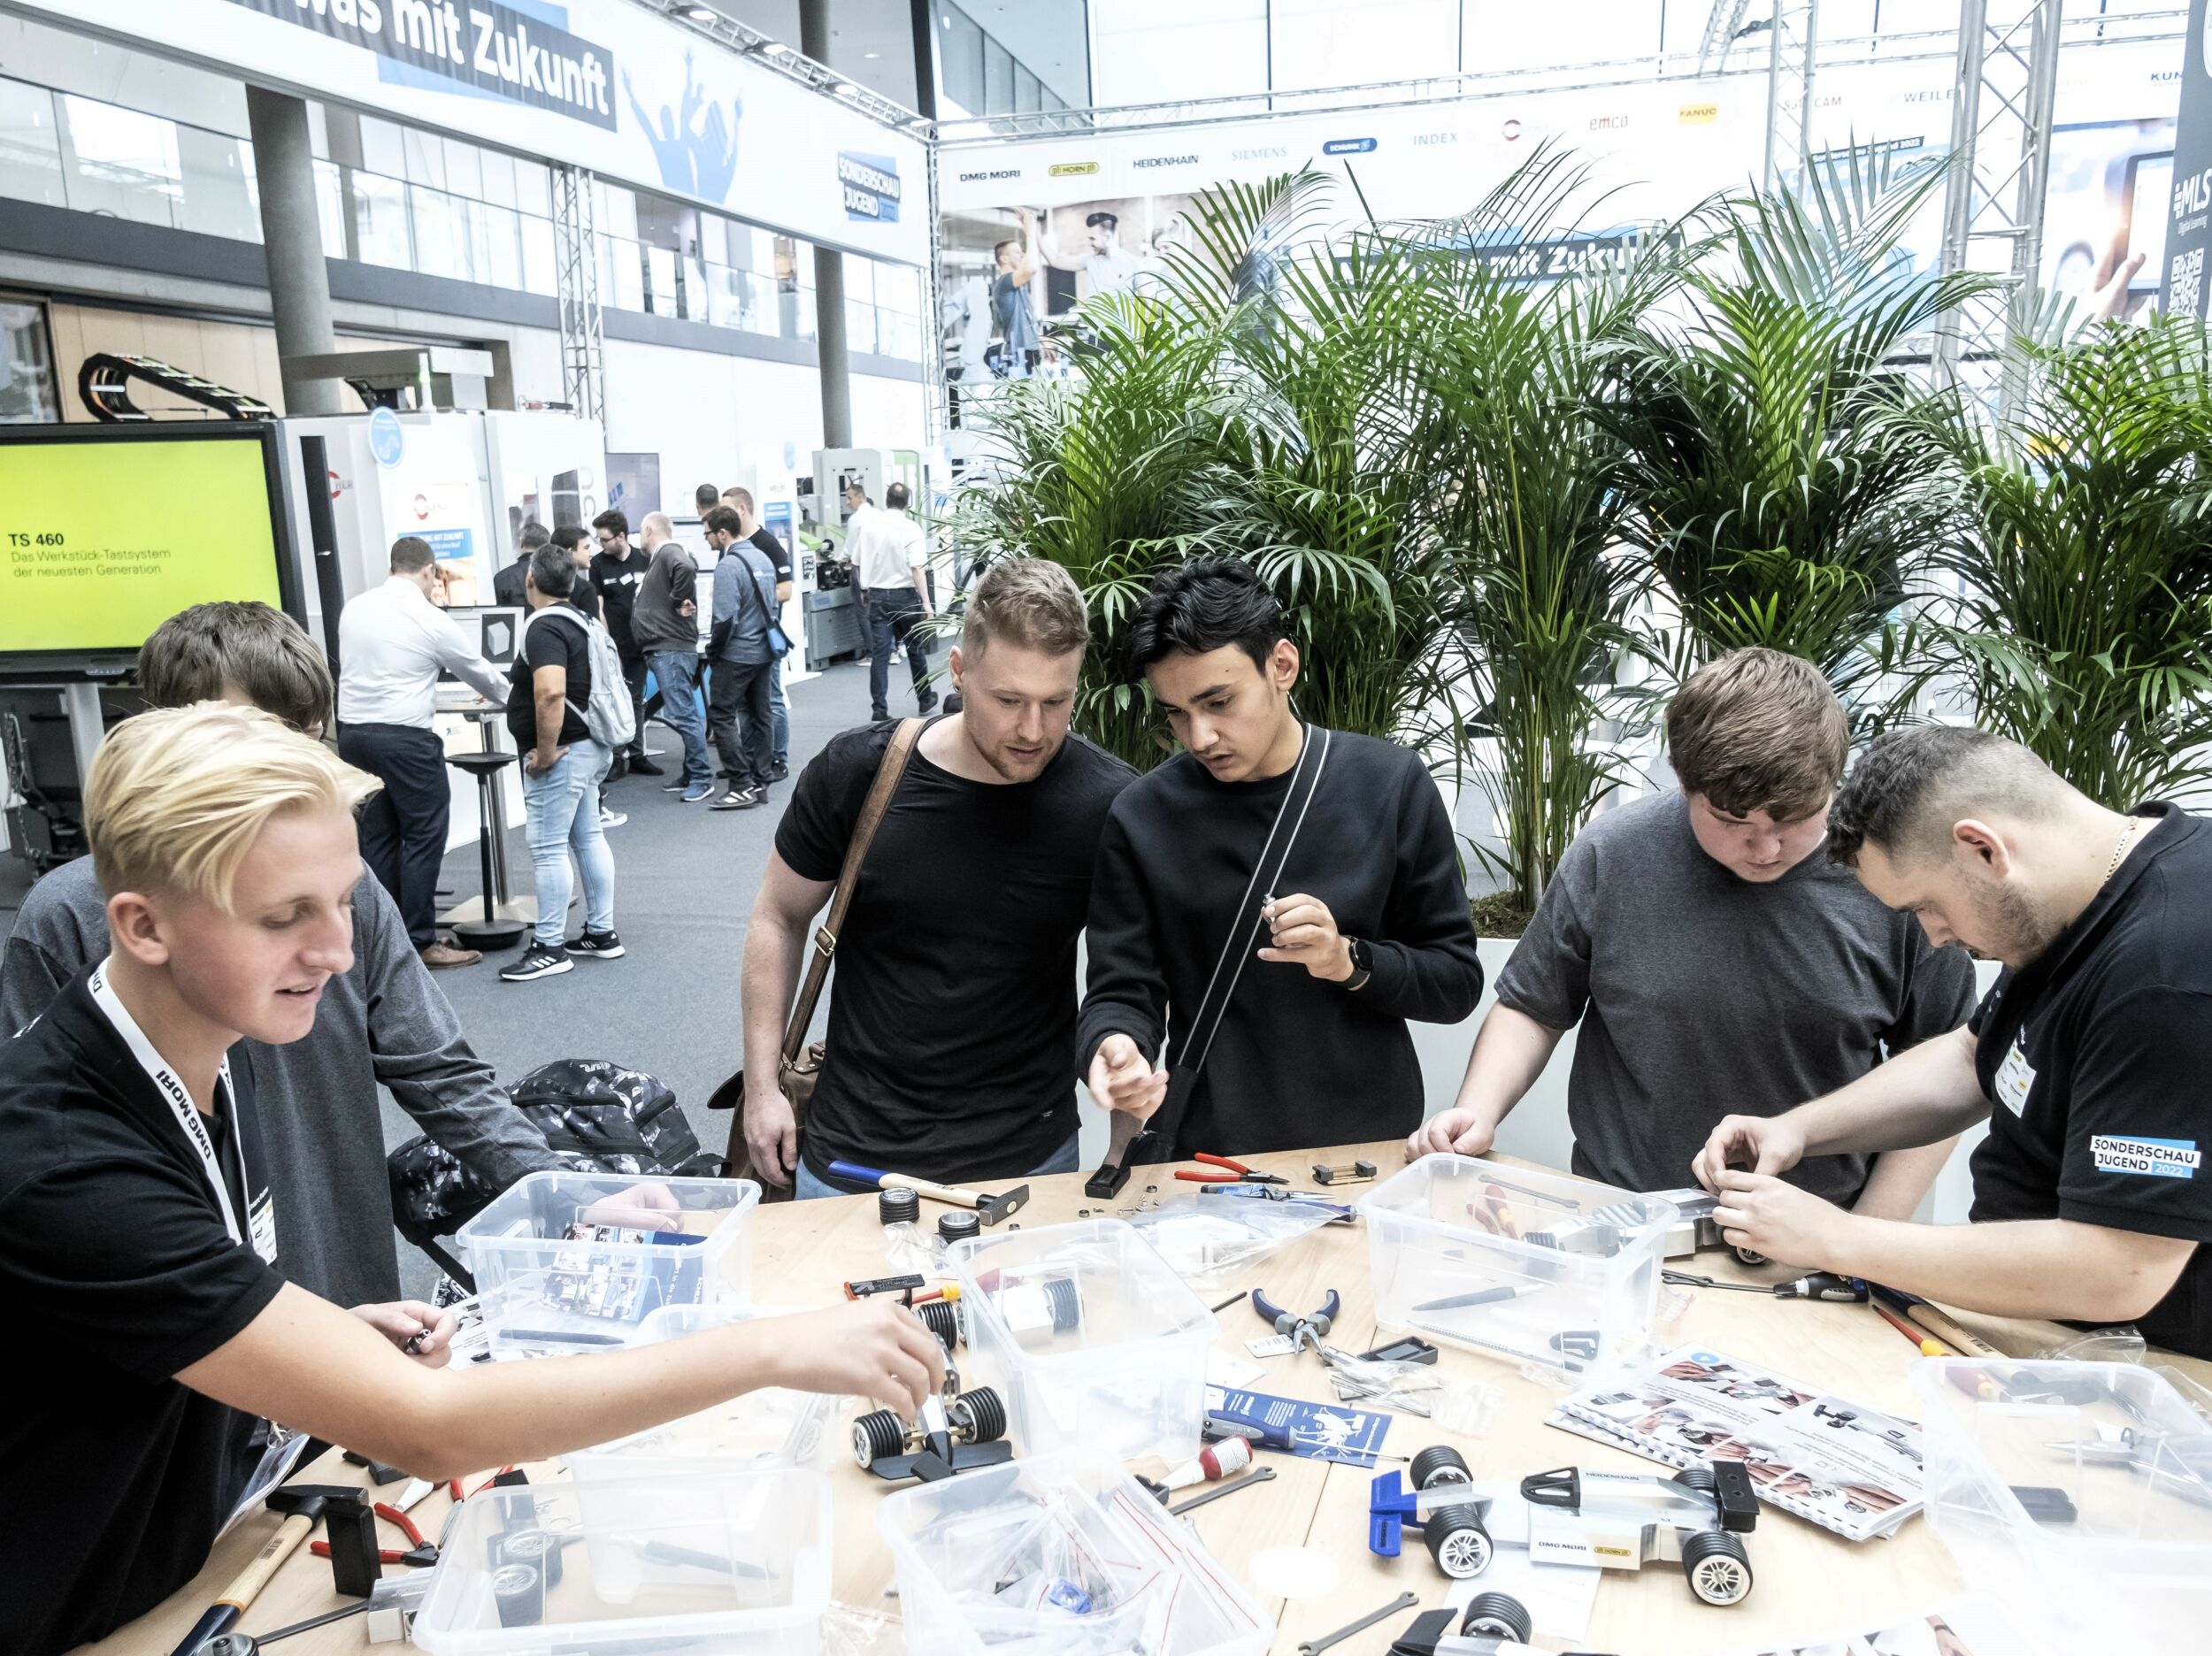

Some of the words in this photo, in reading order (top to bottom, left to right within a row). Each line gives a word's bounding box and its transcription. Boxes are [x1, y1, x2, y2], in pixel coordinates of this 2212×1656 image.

[392, 0, 465, 65] mit
[469, 8, 610, 116] Zukunft
[1904, 89, 1956, 102] WEILE
[1679, 106, 1717, 118] FANUC
[1589, 115, 1628, 131] emco
[1413, 133, 1458, 146] INDEX
[1231, 146, 1287, 161] SIEMENS
[1133, 155, 1199, 168] HEIDENHAIN
[960, 172, 987, 182] DMG
[989, 170, 1021, 180] MORI
[1062, 165, 1086, 174] HORN
[8, 533, 31, 547] TS
[35, 533, 64, 547] 460
[12, 551, 35, 563] Das
[37, 548, 172, 562] Werkstück-Tastsystem
[13, 568, 33, 578] der
[37, 565, 93, 577] neuesten
[96, 564, 162, 576] Generation
[156, 1070, 194, 1119] MORI
[188, 1116, 211, 1161] DMG
[2093, 1138, 2195, 1164] SONDERSCHAU
[2098, 1153, 2149, 1171] JUGEND
[2155, 1163, 2184, 1177] 2022
[1562, 1542, 1586, 1551] MORI
